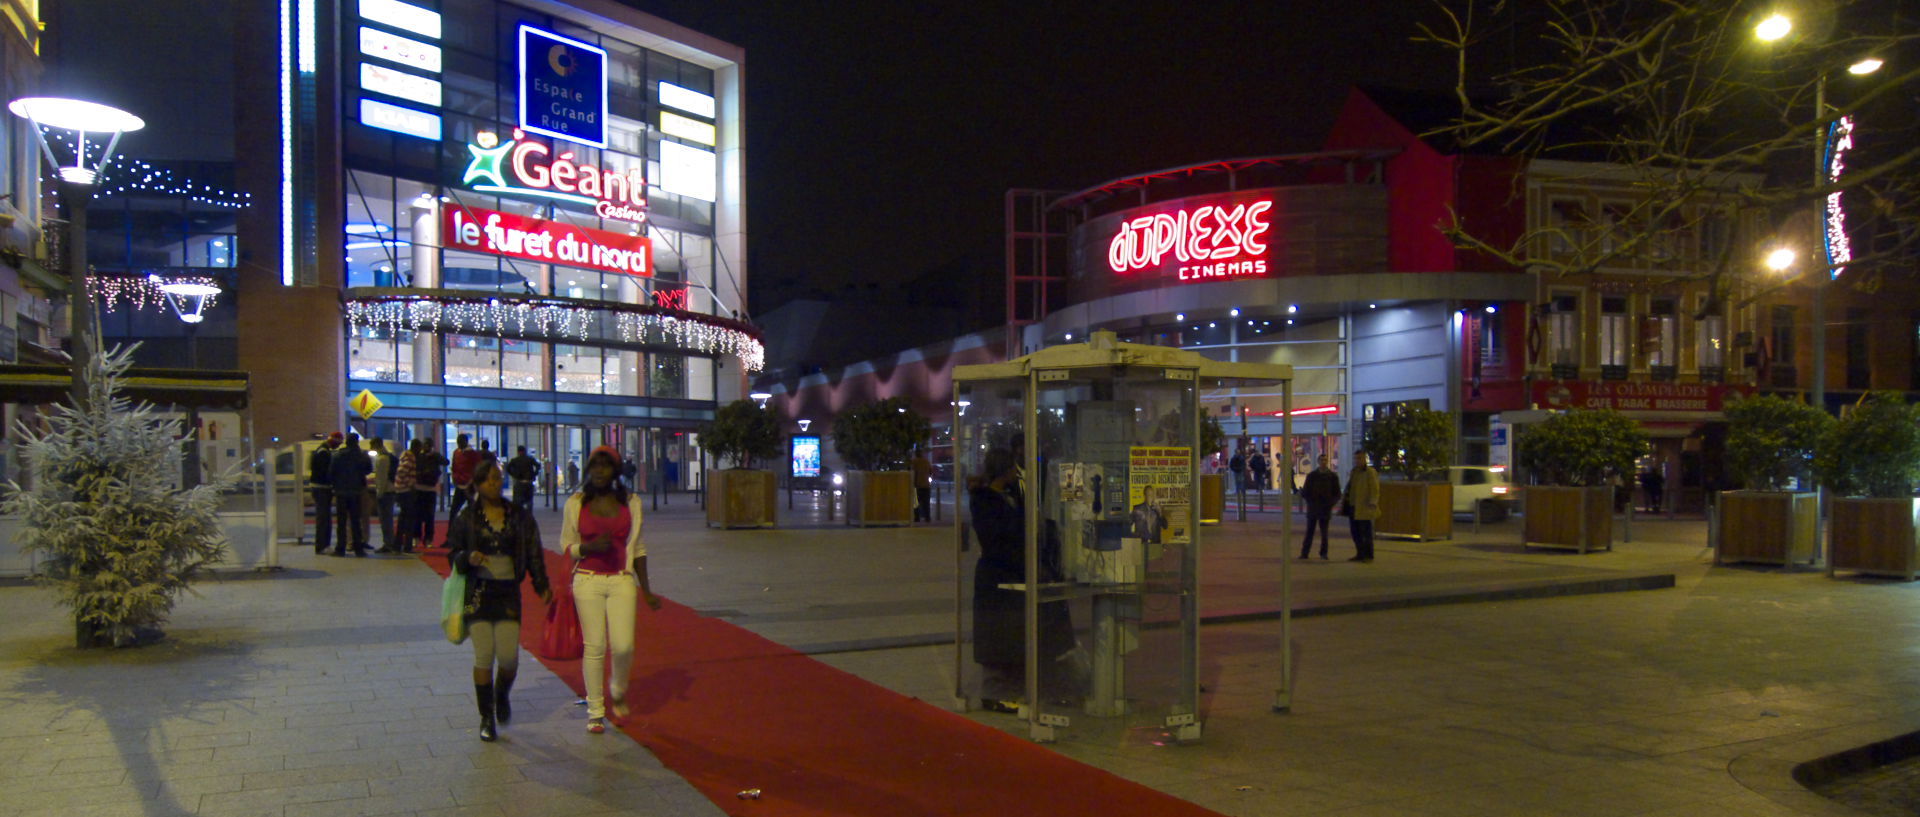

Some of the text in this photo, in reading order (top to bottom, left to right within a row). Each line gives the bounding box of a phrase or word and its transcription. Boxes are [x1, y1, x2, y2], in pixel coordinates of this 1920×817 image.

[534, 78, 583, 102] Espace
[541, 114, 569, 132] Rue
[551, 102, 595, 124] Grand
[513, 141, 646, 206] Géant
[595, 200, 646, 222] Casino
[453, 210, 646, 272] le furet du nord
[1587, 383, 1708, 397] LES OLYMPIADES
[1618, 398, 1651, 409] TABAC
[1655, 398, 1708, 409] BRASSERIE
